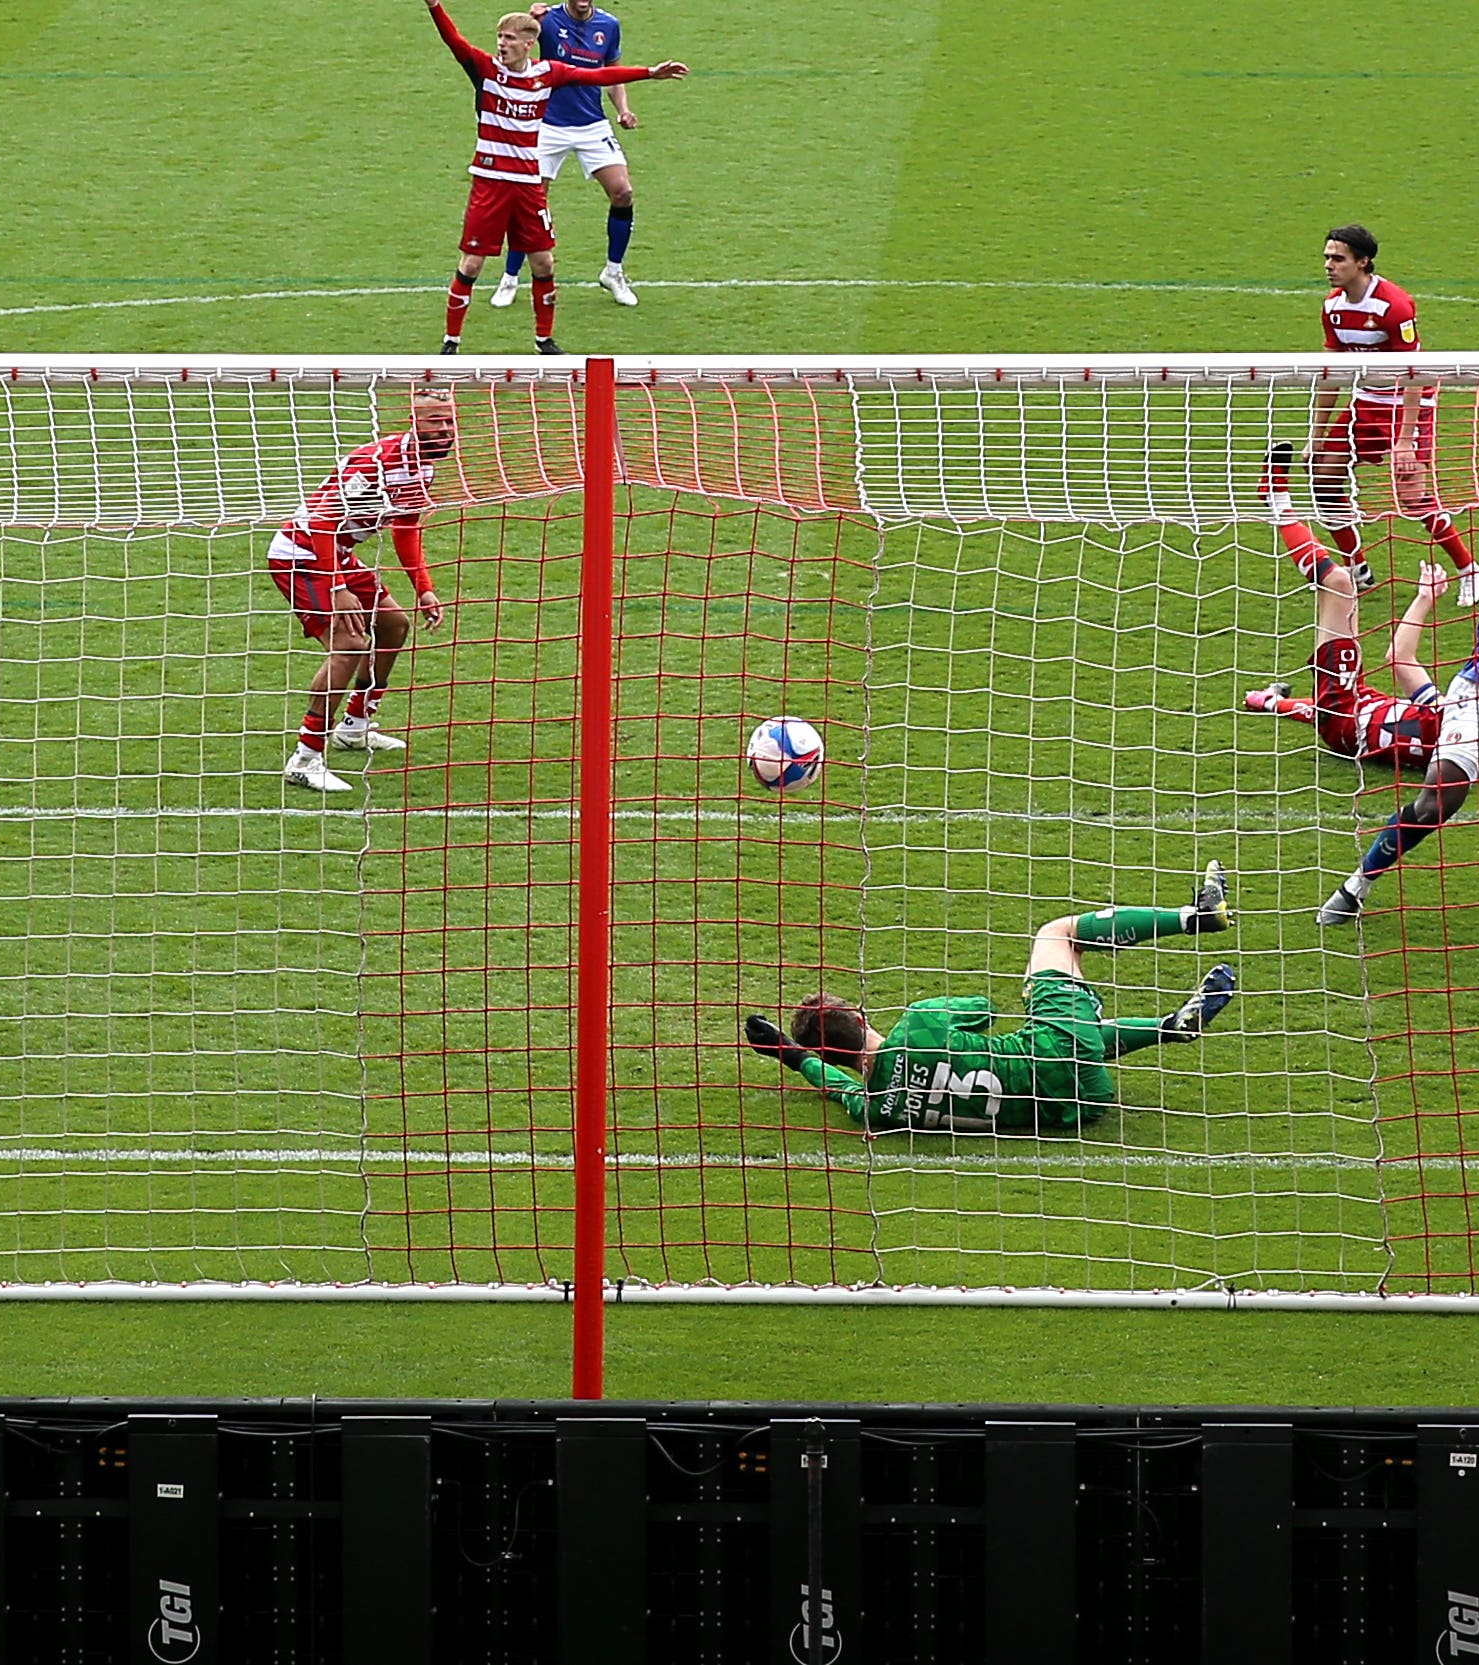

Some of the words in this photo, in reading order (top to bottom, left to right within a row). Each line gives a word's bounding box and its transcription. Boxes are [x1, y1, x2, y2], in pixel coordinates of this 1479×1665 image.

[496, 98, 538, 118] LNER
[905, 1063, 930, 1118] JONES
[159, 1579, 194, 1646] TGI
